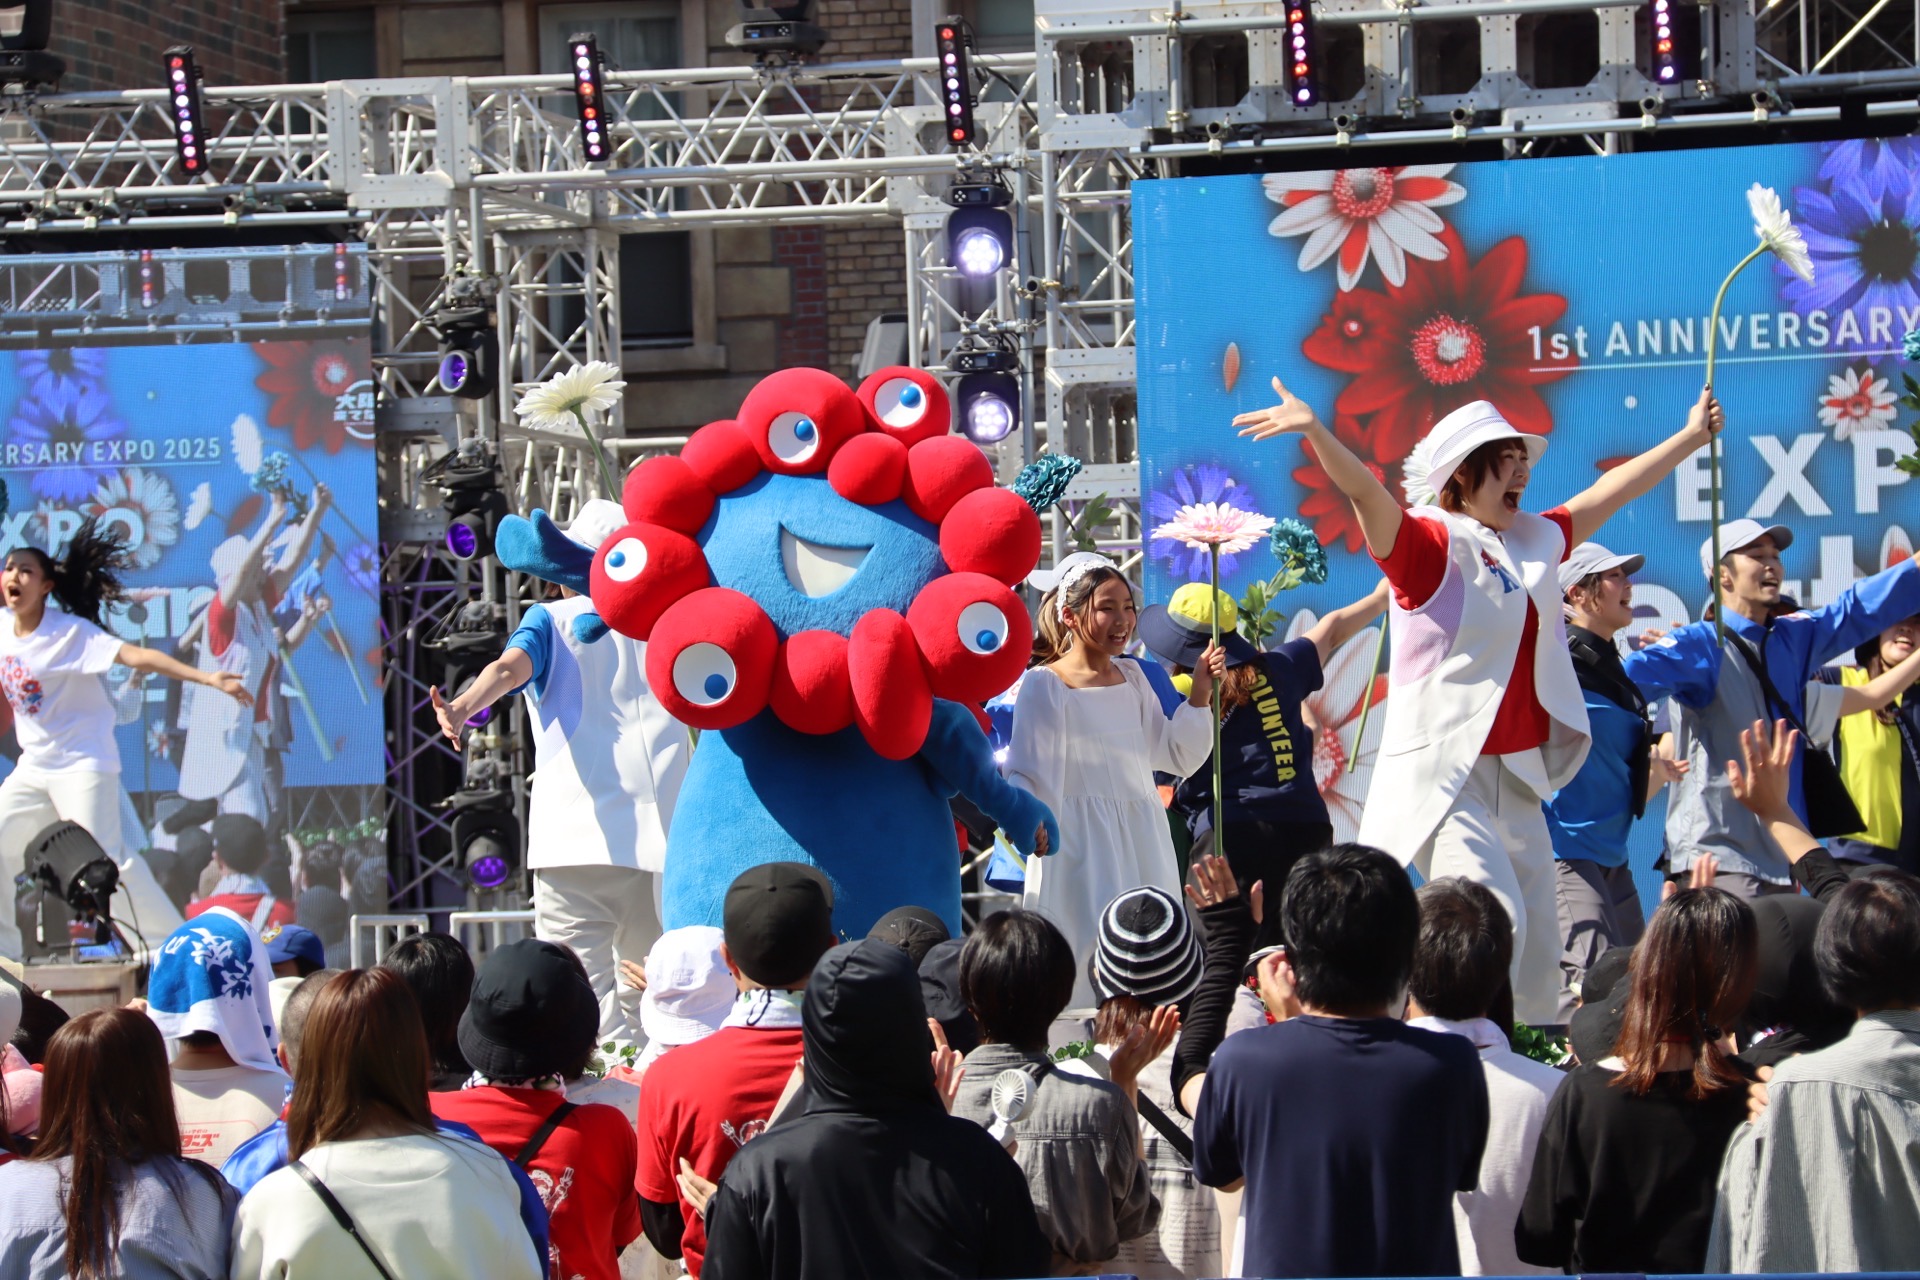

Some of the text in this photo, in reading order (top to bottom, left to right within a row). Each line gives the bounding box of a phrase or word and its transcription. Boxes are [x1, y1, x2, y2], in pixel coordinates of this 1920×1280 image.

[1527, 305, 1920, 361] 1st ANNIVERSARY
[93, 439, 155, 462] EXPO
[164, 437, 221, 460] 2025
[1248, 673, 1296, 782] OLUNTEER
